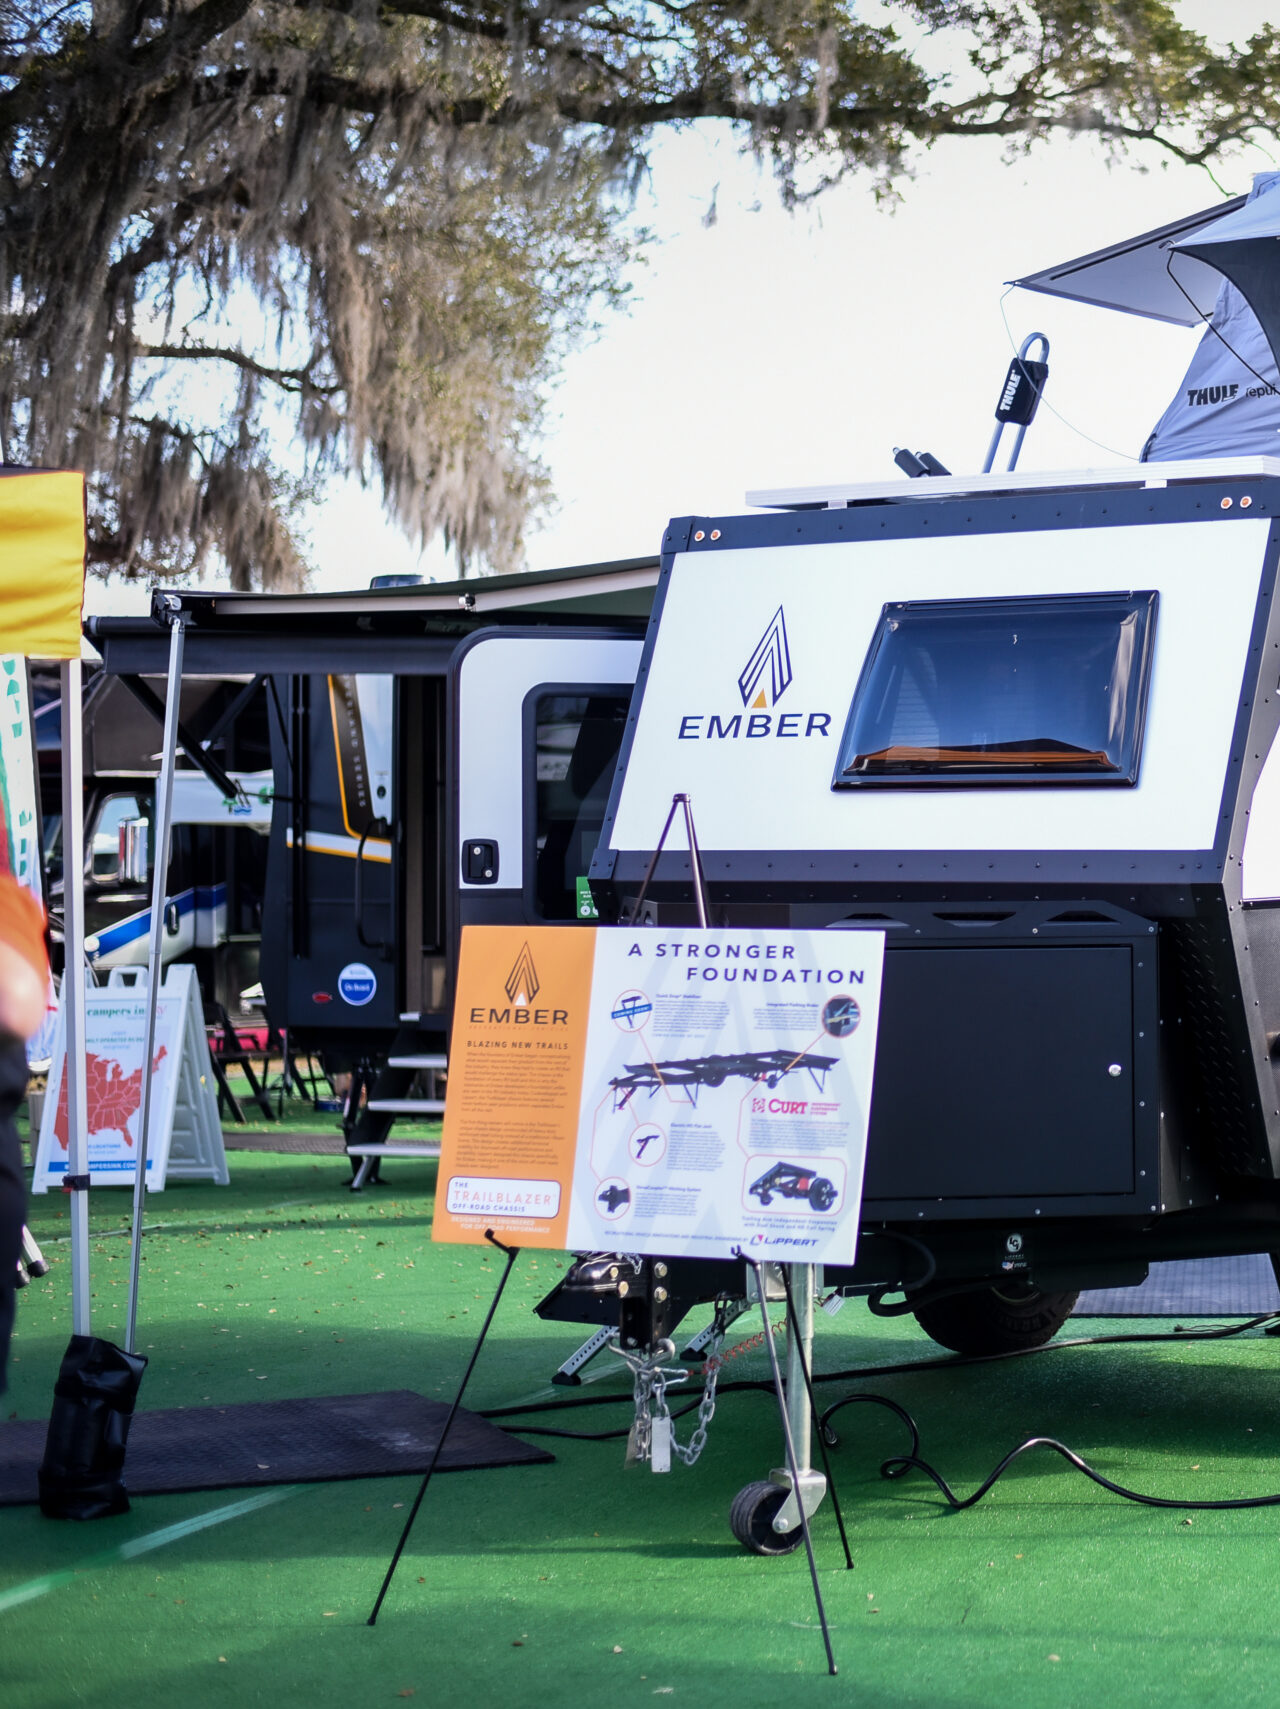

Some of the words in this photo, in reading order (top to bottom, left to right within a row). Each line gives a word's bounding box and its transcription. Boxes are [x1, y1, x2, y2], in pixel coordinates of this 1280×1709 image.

[1000, 373, 1021, 410] THULE
[1188, 384, 1238, 406] THULE
[678, 713, 832, 740] EMBER
[628, 944, 642, 956] A
[656, 944, 795, 959] STRONGER
[687, 968, 864, 984] FOUNDATION
[470, 1008, 569, 1025] EMBER
[467, 1040, 508, 1048] BLAZING
[769, 1099, 808, 1114] CURT
[454, 1190, 552, 1205] TRAILBLAZER
